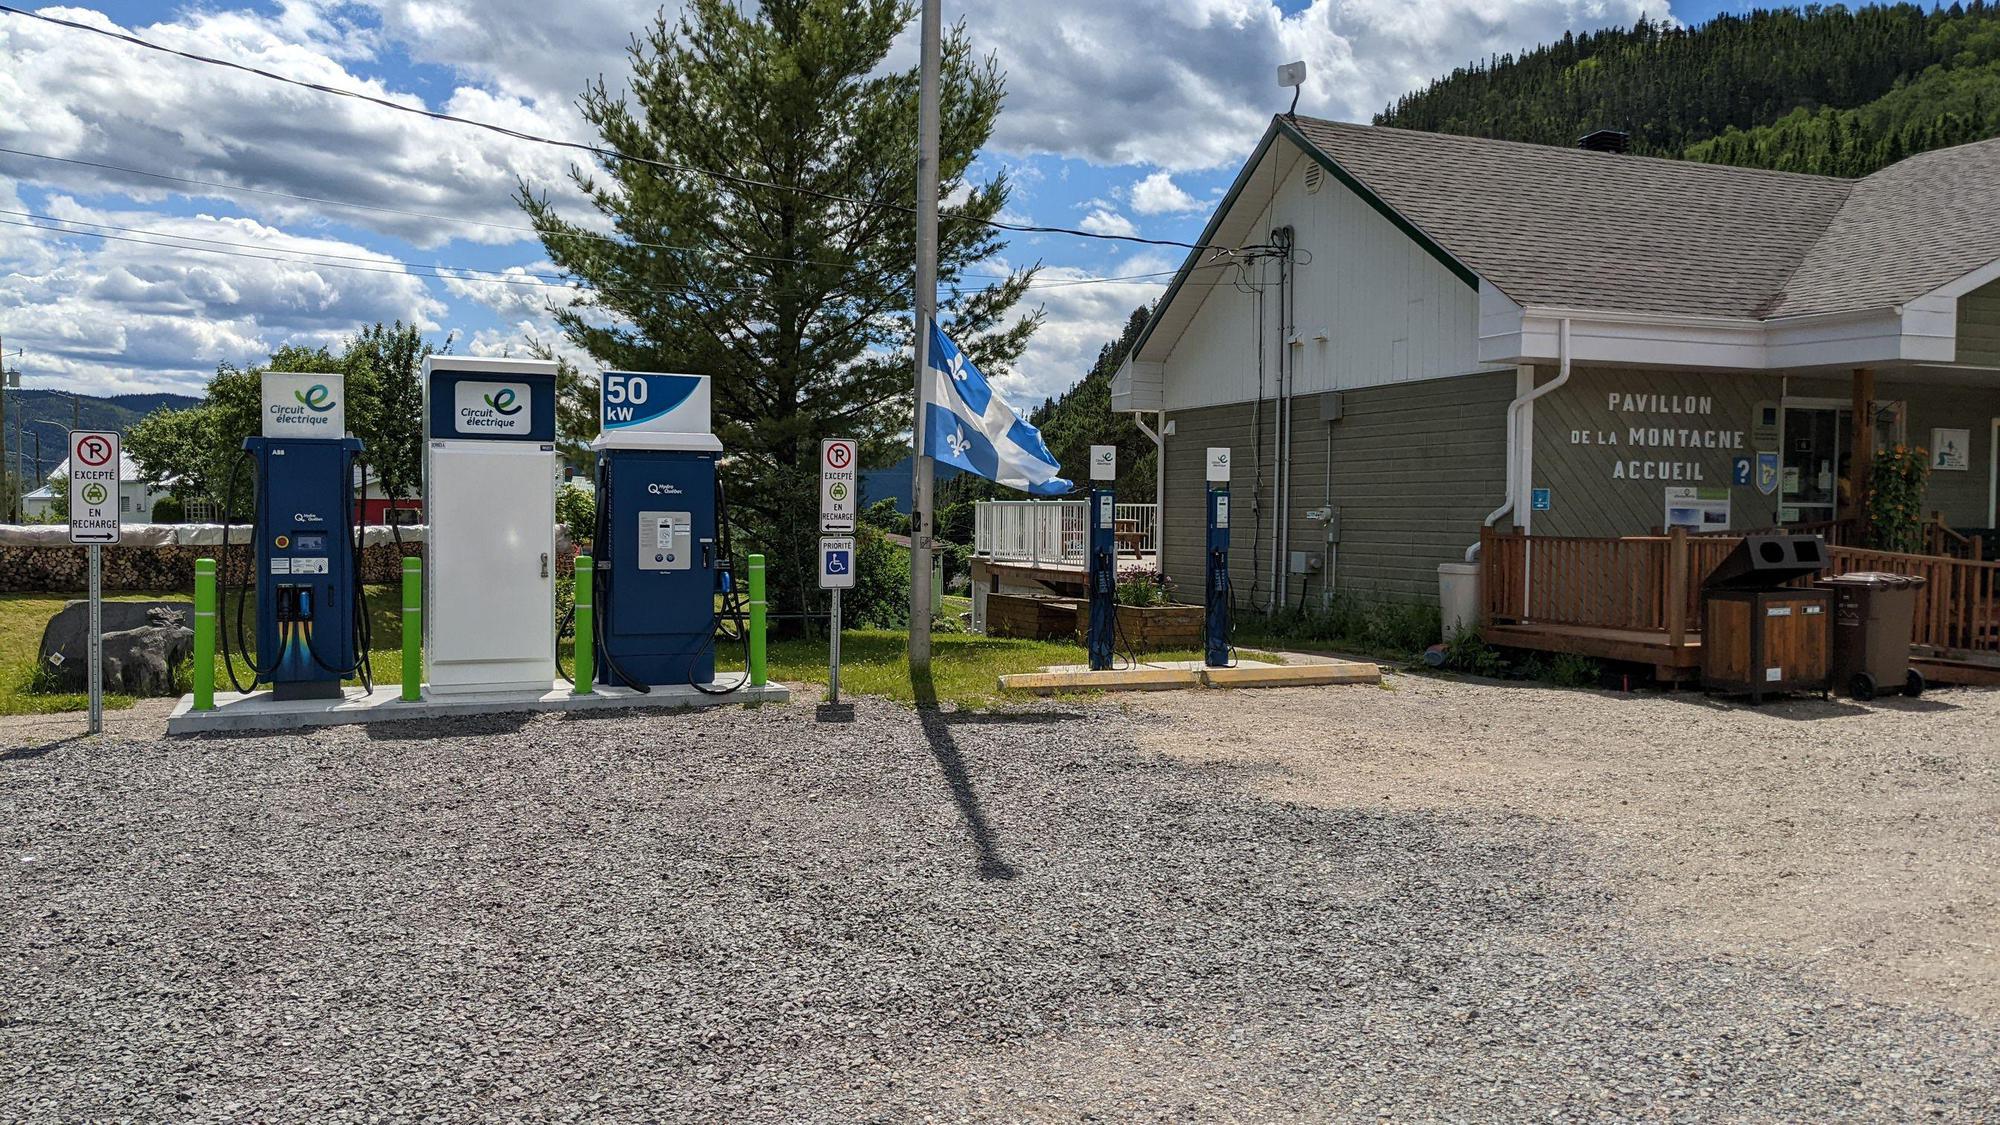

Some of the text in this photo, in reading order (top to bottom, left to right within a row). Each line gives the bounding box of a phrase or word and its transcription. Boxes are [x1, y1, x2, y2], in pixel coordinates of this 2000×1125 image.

[607, 376, 648, 405] 50
[270, 404, 305, 414] Circuit
[1608, 392, 1712, 415] PAVILLON
[461, 408, 493, 417] Circuit
[607, 406, 634, 421] kW
[276, 413, 329, 426] électrique
[466, 416, 515, 428] électrique
[1571, 430, 1590, 444] DE
[1598, 431, 1617, 445] LA
[1629, 427, 1744, 449] MONTAGNE
[74, 469, 115, 480] EXCEPTÉ
[825, 472, 853, 480] EXCEPTÉ
[1612, 460, 1704, 481] ACCUEIL
[89, 508, 101, 517] EN
[822, 513, 853, 521] RECHARGE
[72, 519, 117, 529] RECHARGE
[823, 542, 851, 550] PRIORITÉ
